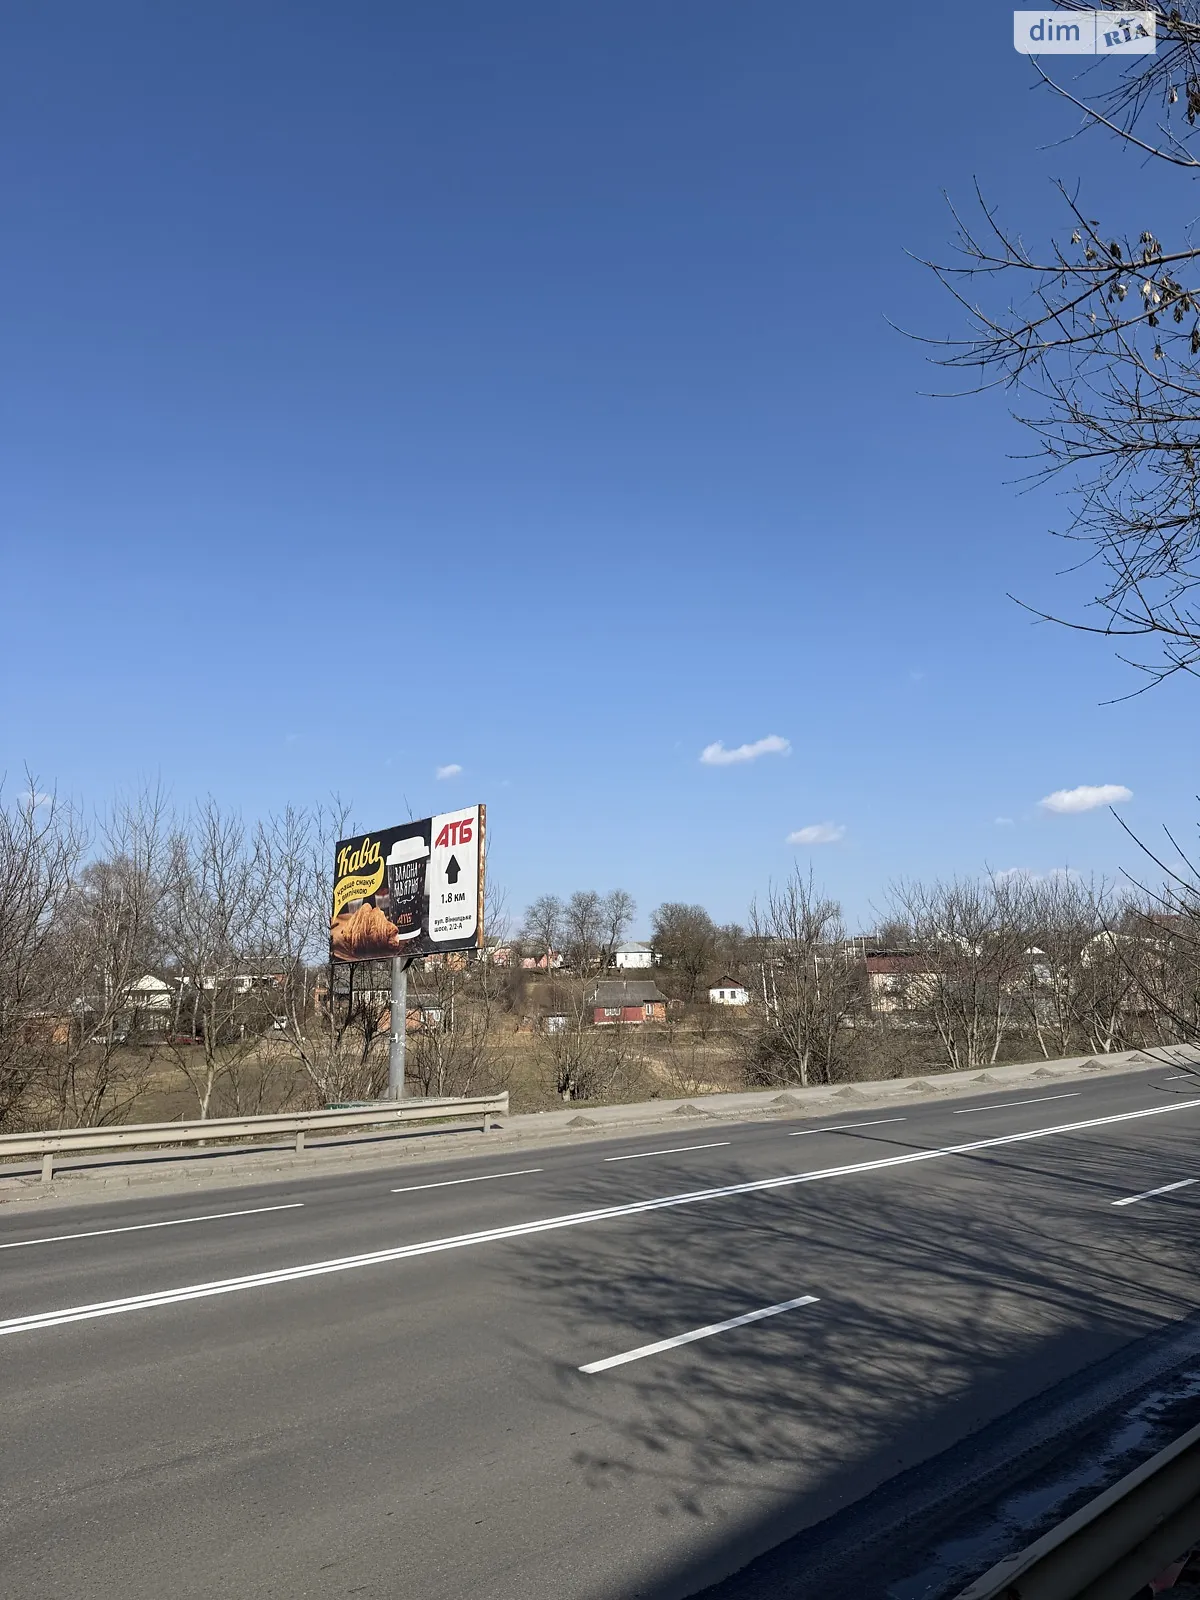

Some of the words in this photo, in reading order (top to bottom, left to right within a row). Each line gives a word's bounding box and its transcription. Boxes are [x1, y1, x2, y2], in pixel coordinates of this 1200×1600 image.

[435, 817, 474, 849] АТБ
[337, 837, 381, 877] Кава
[336, 881, 355, 896] краще
[355, 878, 375, 888] смакує
[441, 892, 453, 904] 1.8
[445, 914, 472, 924] Вінницьке
